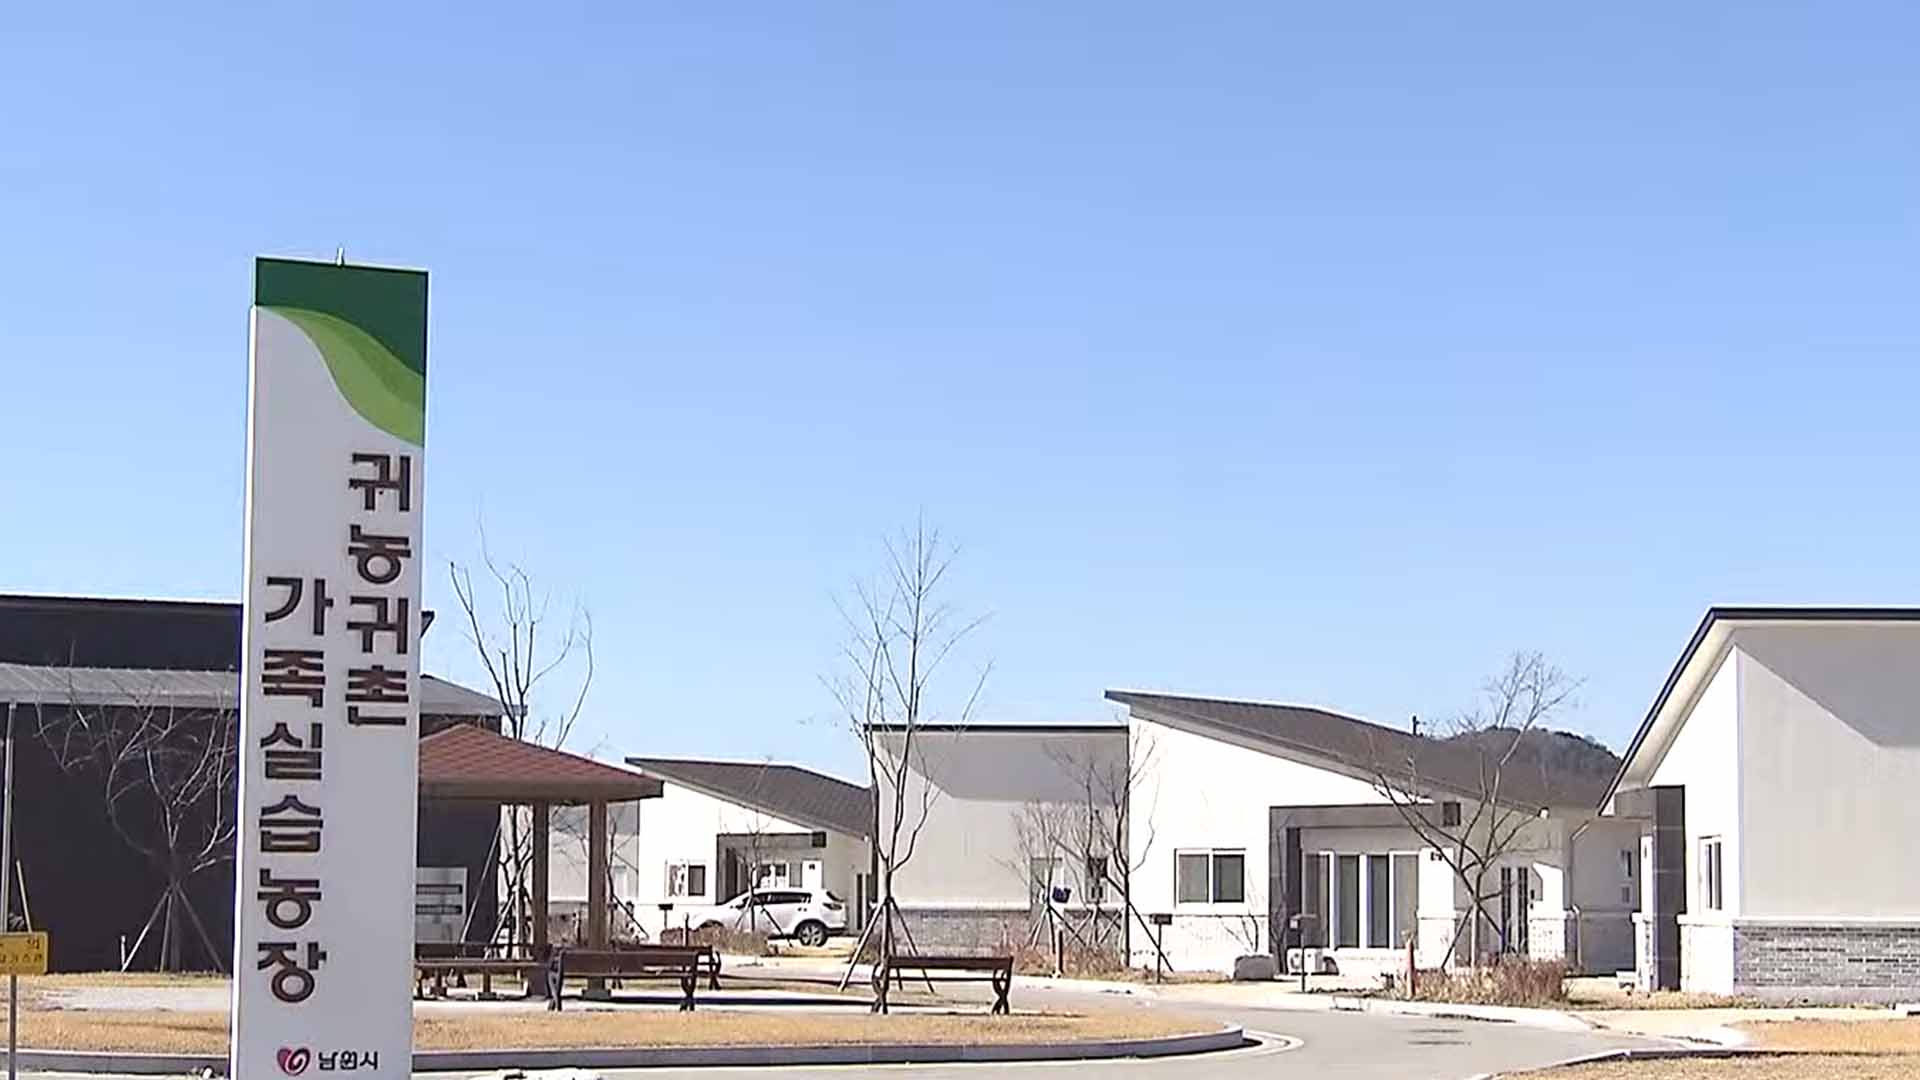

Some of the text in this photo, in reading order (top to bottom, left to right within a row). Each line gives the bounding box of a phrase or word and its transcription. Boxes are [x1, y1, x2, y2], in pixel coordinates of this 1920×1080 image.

[346, 452, 411, 726] 귀농귀촌
[257, 576, 334, 1003] 가족실습농장
[318, 1050, 378, 1070] 남원시
